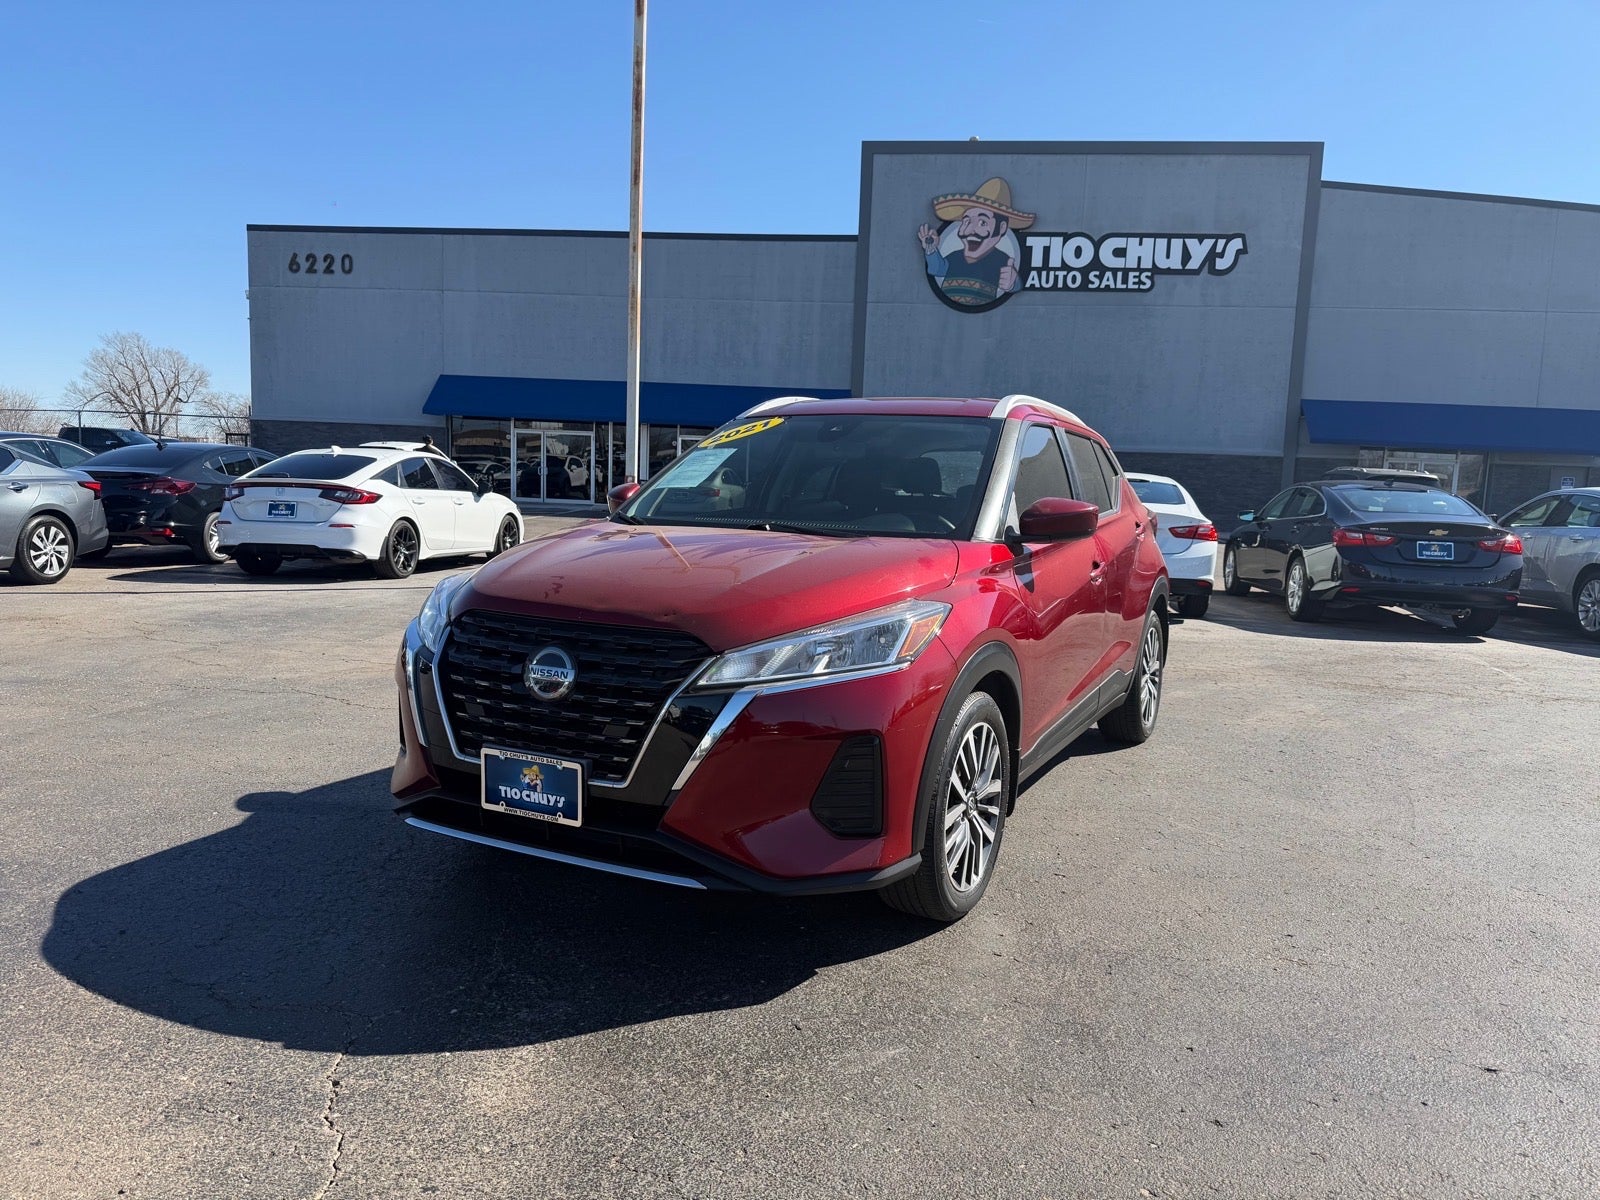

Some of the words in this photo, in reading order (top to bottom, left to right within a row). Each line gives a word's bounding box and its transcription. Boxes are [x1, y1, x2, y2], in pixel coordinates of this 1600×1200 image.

[288, 252, 353, 274] 6220
[1026, 236, 1094, 268] TIO
[1099, 237, 1243, 270] CHUY'S
[1025, 271, 1082, 289] AUTO
[1088, 271, 1152, 289] SALES
[707, 420, 772, 445] 2021
[531, 667, 569, 680] NISSAN
[530, 755, 545, 763] AUTO
[499, 785, 520, 800] TIO
[522, 790, 565, 808] CHUY'S
